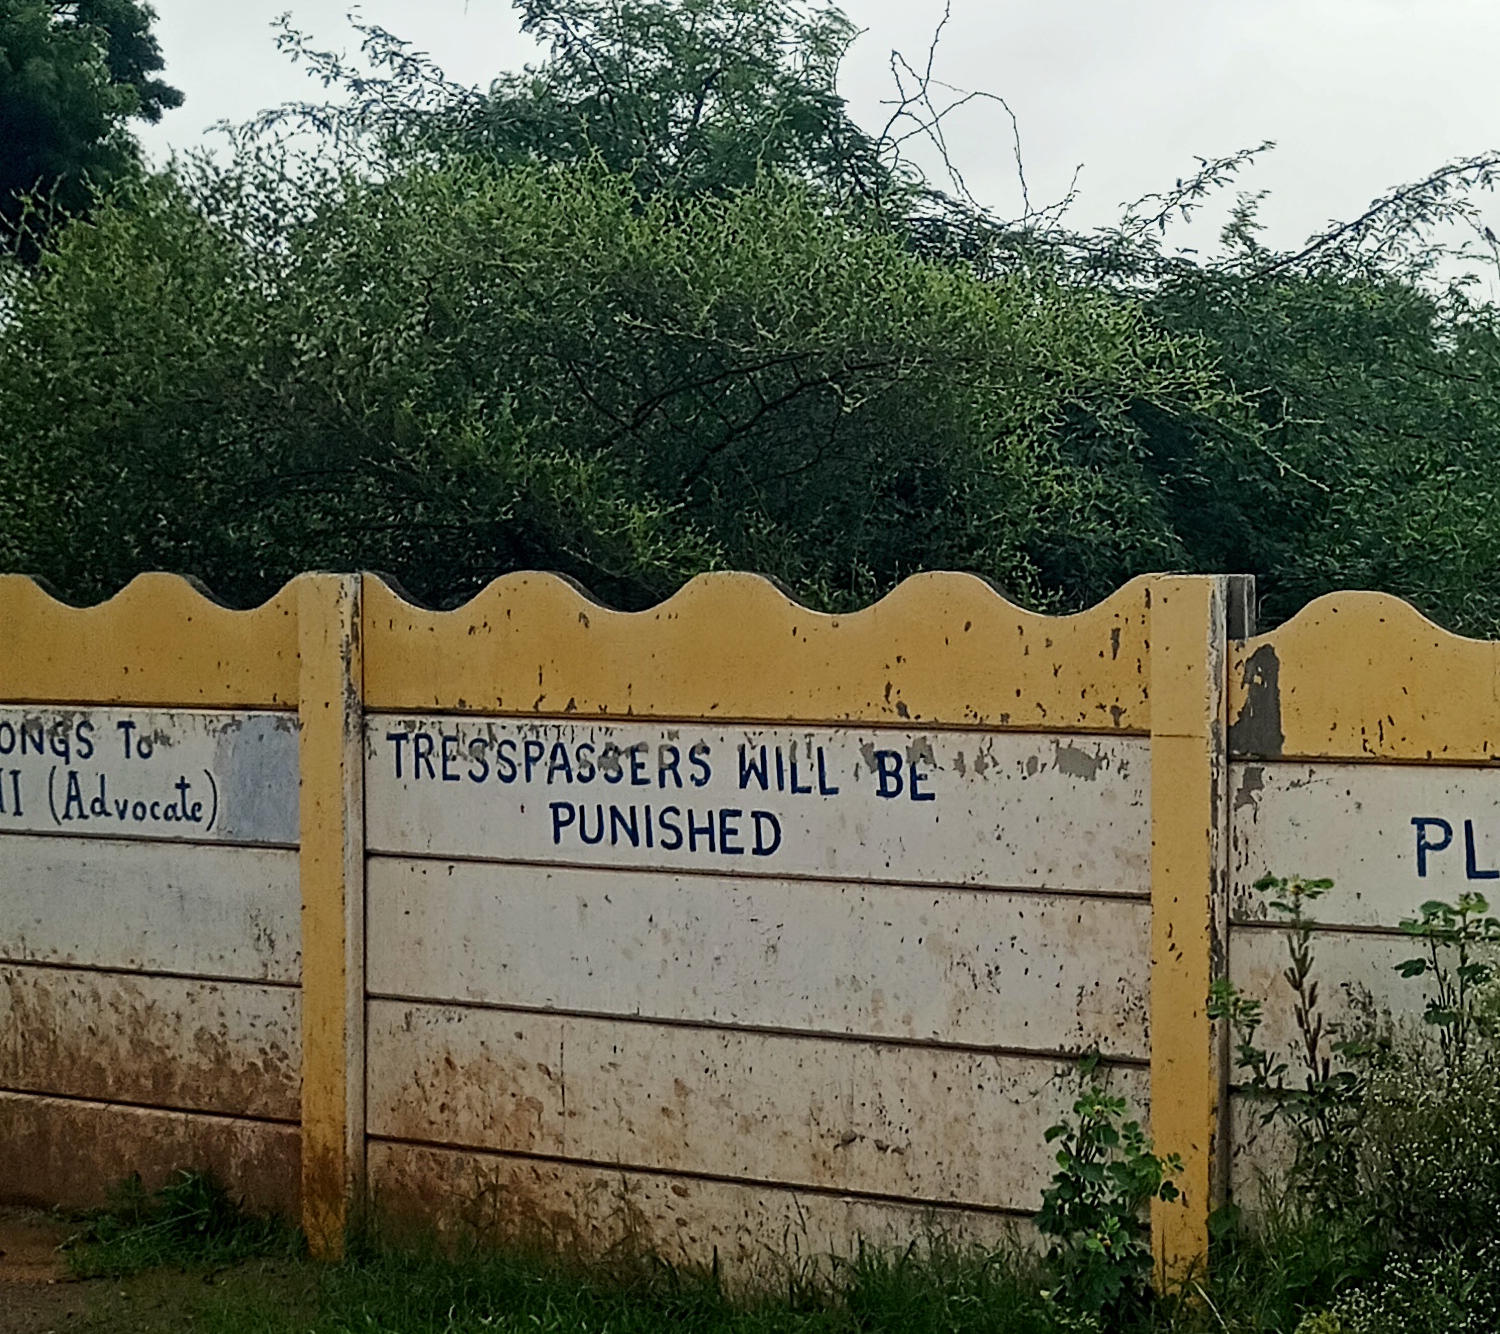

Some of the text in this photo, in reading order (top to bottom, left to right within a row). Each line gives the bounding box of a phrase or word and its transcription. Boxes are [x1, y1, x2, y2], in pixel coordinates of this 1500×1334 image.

[49, 766, 217, 831] (Advocate)
[386, 732, 936, 800] TRESSPASSERS WILL BE
[549, 802, 782, 855] PUNISHED
